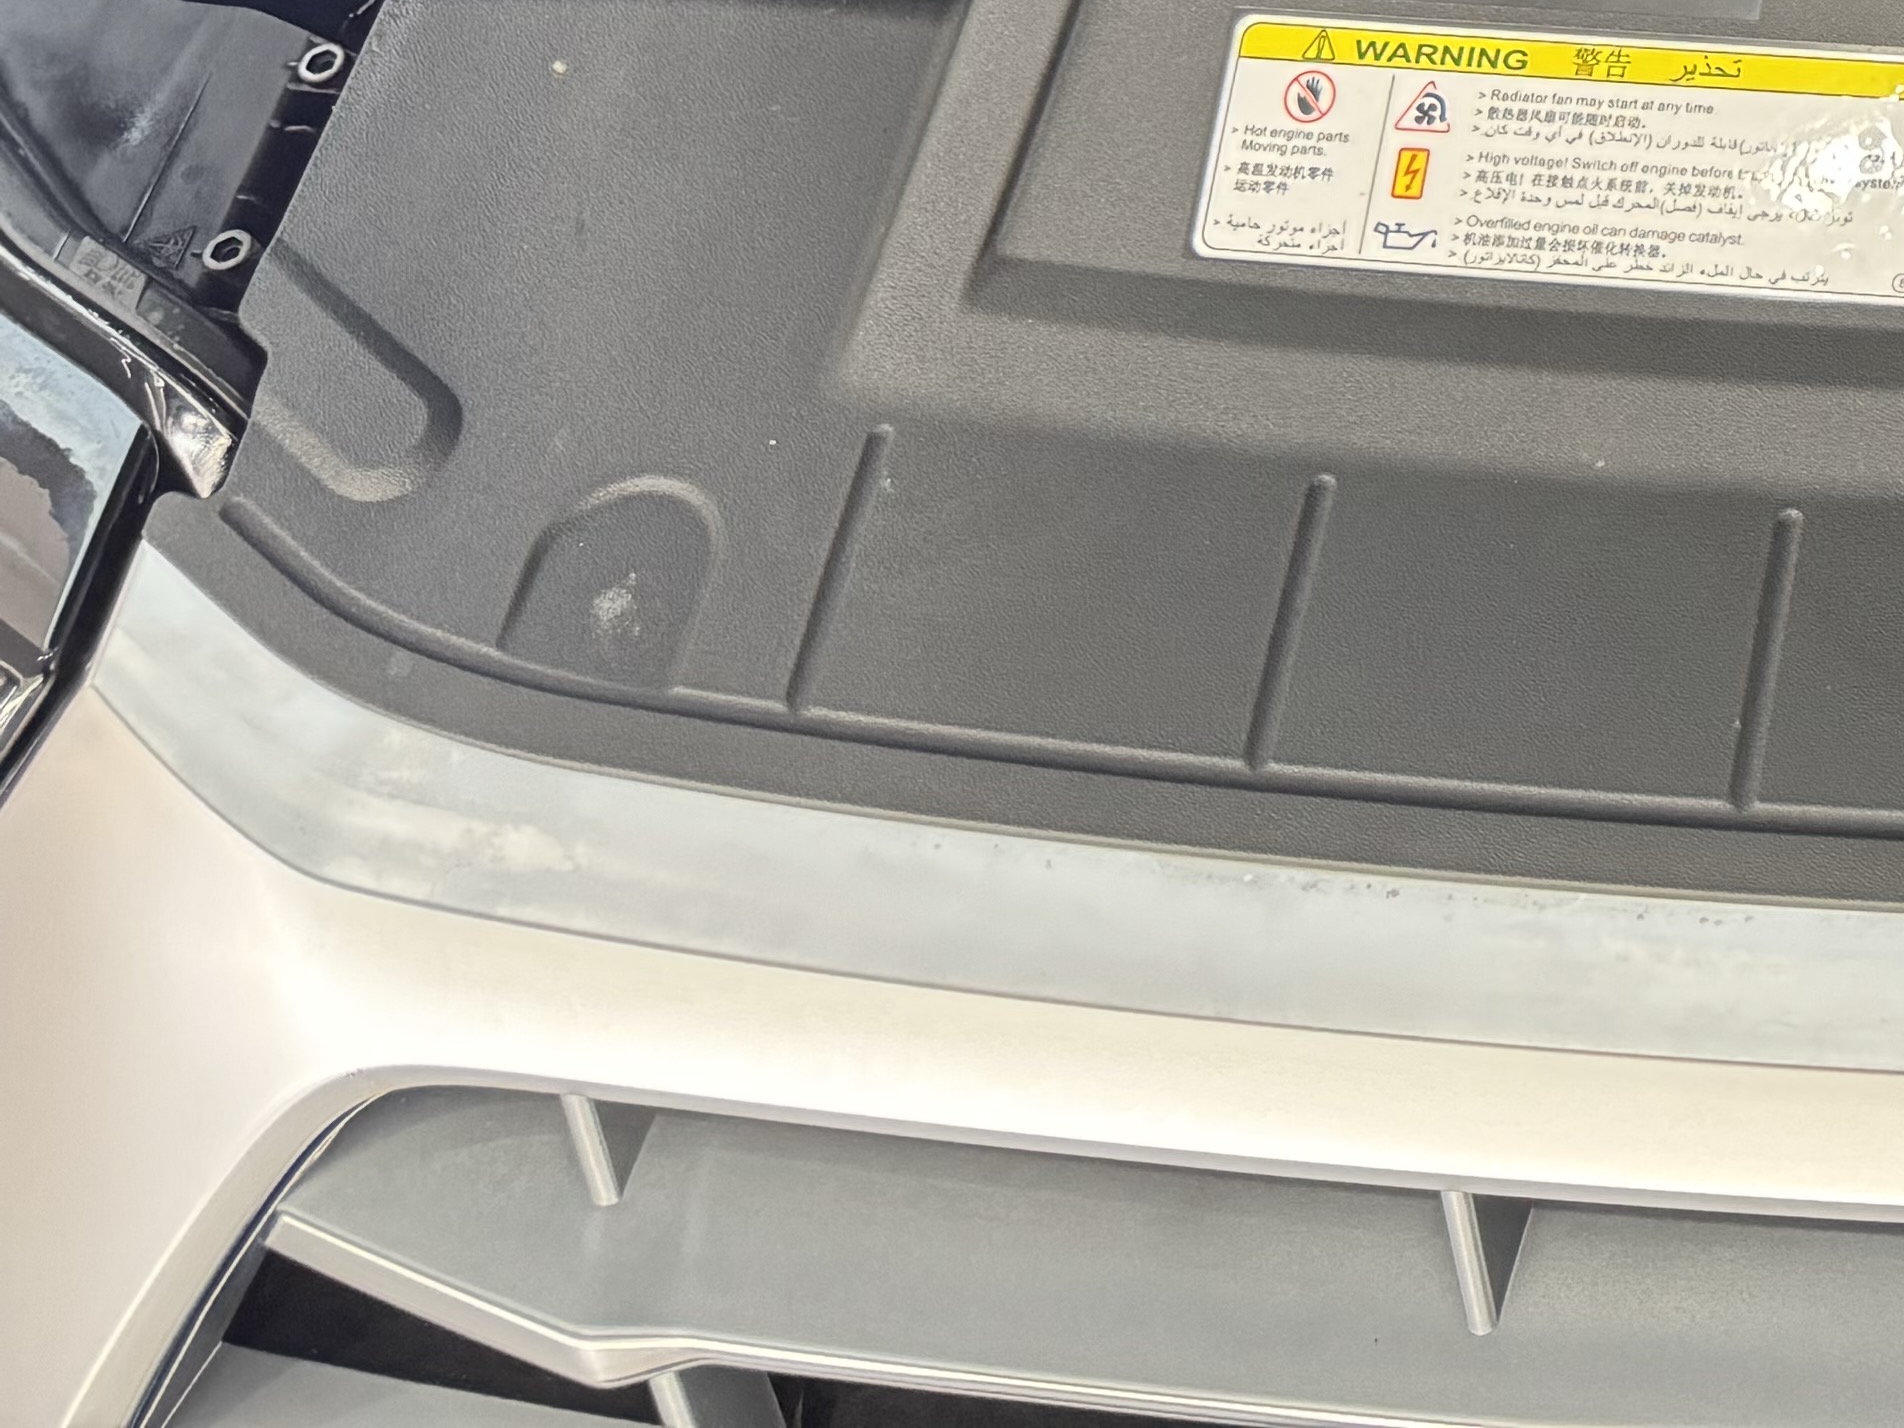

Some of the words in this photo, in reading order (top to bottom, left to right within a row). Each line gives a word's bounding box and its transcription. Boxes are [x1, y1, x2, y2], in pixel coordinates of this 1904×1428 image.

[1355, 39, 1530, 72] WARNING
[1573, 46, 1632, 80] 警告
[1669, 54, 1742, 84] تحذير
[1490, 88, 1548, 105] Radiator
[1551, 92, 1573, 105] fan
[1576, 96, 1605, 111] may
[1607, 97, 1638, 110] start
[1641, 100, 1655, 112] at
[1657, 101, 1683, 116] any
[1241, 138, 1288, 157] Moving
[1243, 124, 1268, 138] Hot
[1269, 128, 1315, 142] engine
[1478, 151, 1510, 167] High
[1571, 157, 1617, 172] Switch
[1620, 161, 1639, 174] off
[1641, 163, 1688, 179] engine
[1691, 165, 1734, 180] before
[1466, 214, 1532, 231] Overfilled
[1533, 221, 1580, 236] engine
[1582, 223, 1599, 235] oil
[1601, 226, 1627, 238] can
[1629, 226, 1686, 244] damage
